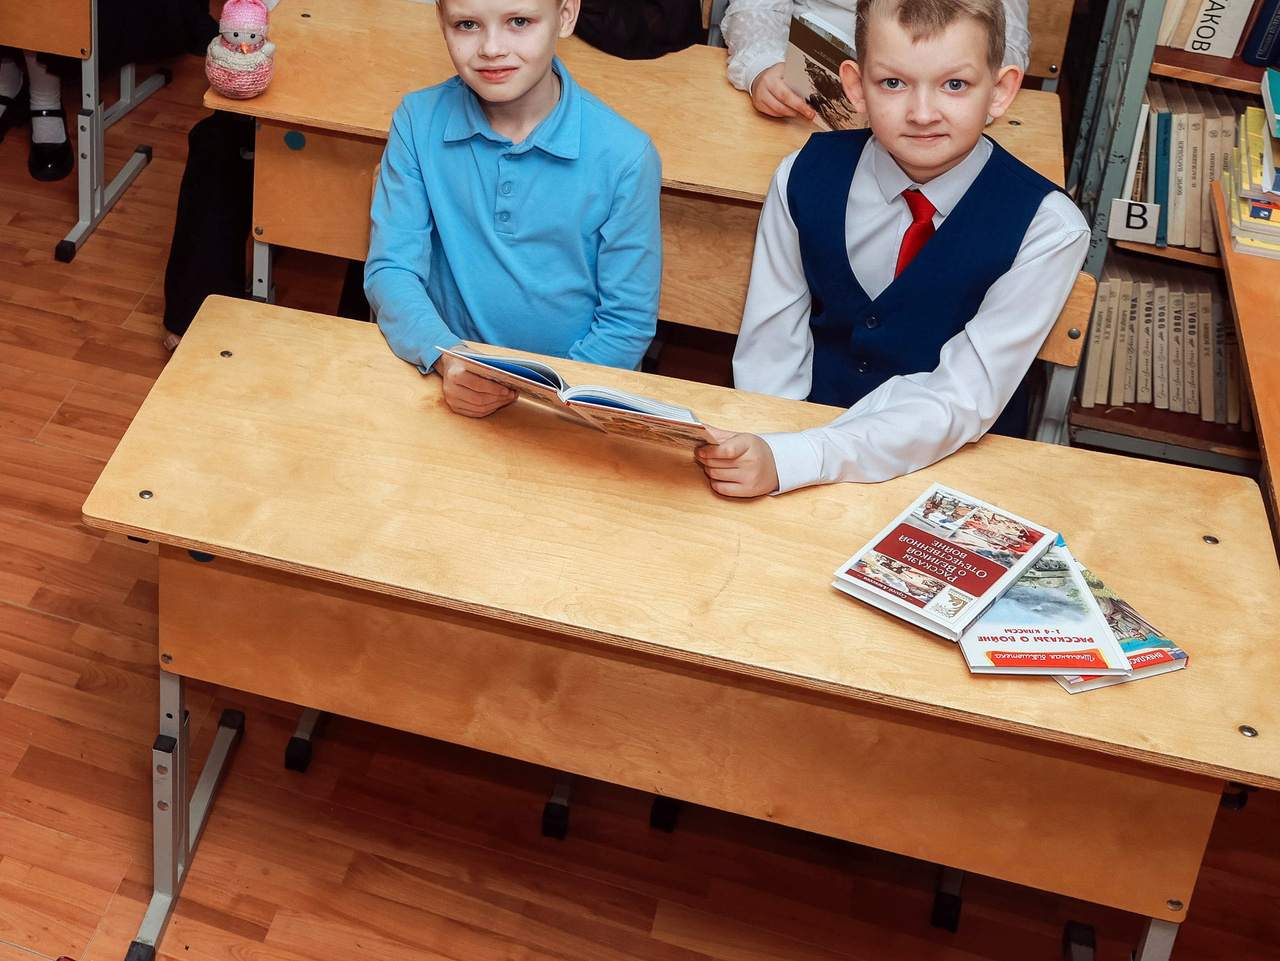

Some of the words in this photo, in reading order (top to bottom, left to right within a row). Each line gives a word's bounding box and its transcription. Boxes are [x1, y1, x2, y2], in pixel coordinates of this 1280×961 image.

[1125, 202, 1149, 231] В
[931, 539, 969, 559] ВОЙНЕ
[898, 534, 988, 579] ОТЕЧЕСТВЕННОЙ
[906, 546, 957, 572] ВЕЛИКОЙ
[902, 553, 959, 583] РАССКАЗЫ
[1004, 627, 1042, 635] КЛАССЫ
[977, 634, 1021, 643] ВОЙНЕ
[1023, 635, 1031, 643] О
[1034, 635, 1095, 644] РАССКАЗЫ
[993, 652, 1049, 661] библиотека
[1051, 653, 1096, 663] Школьная
